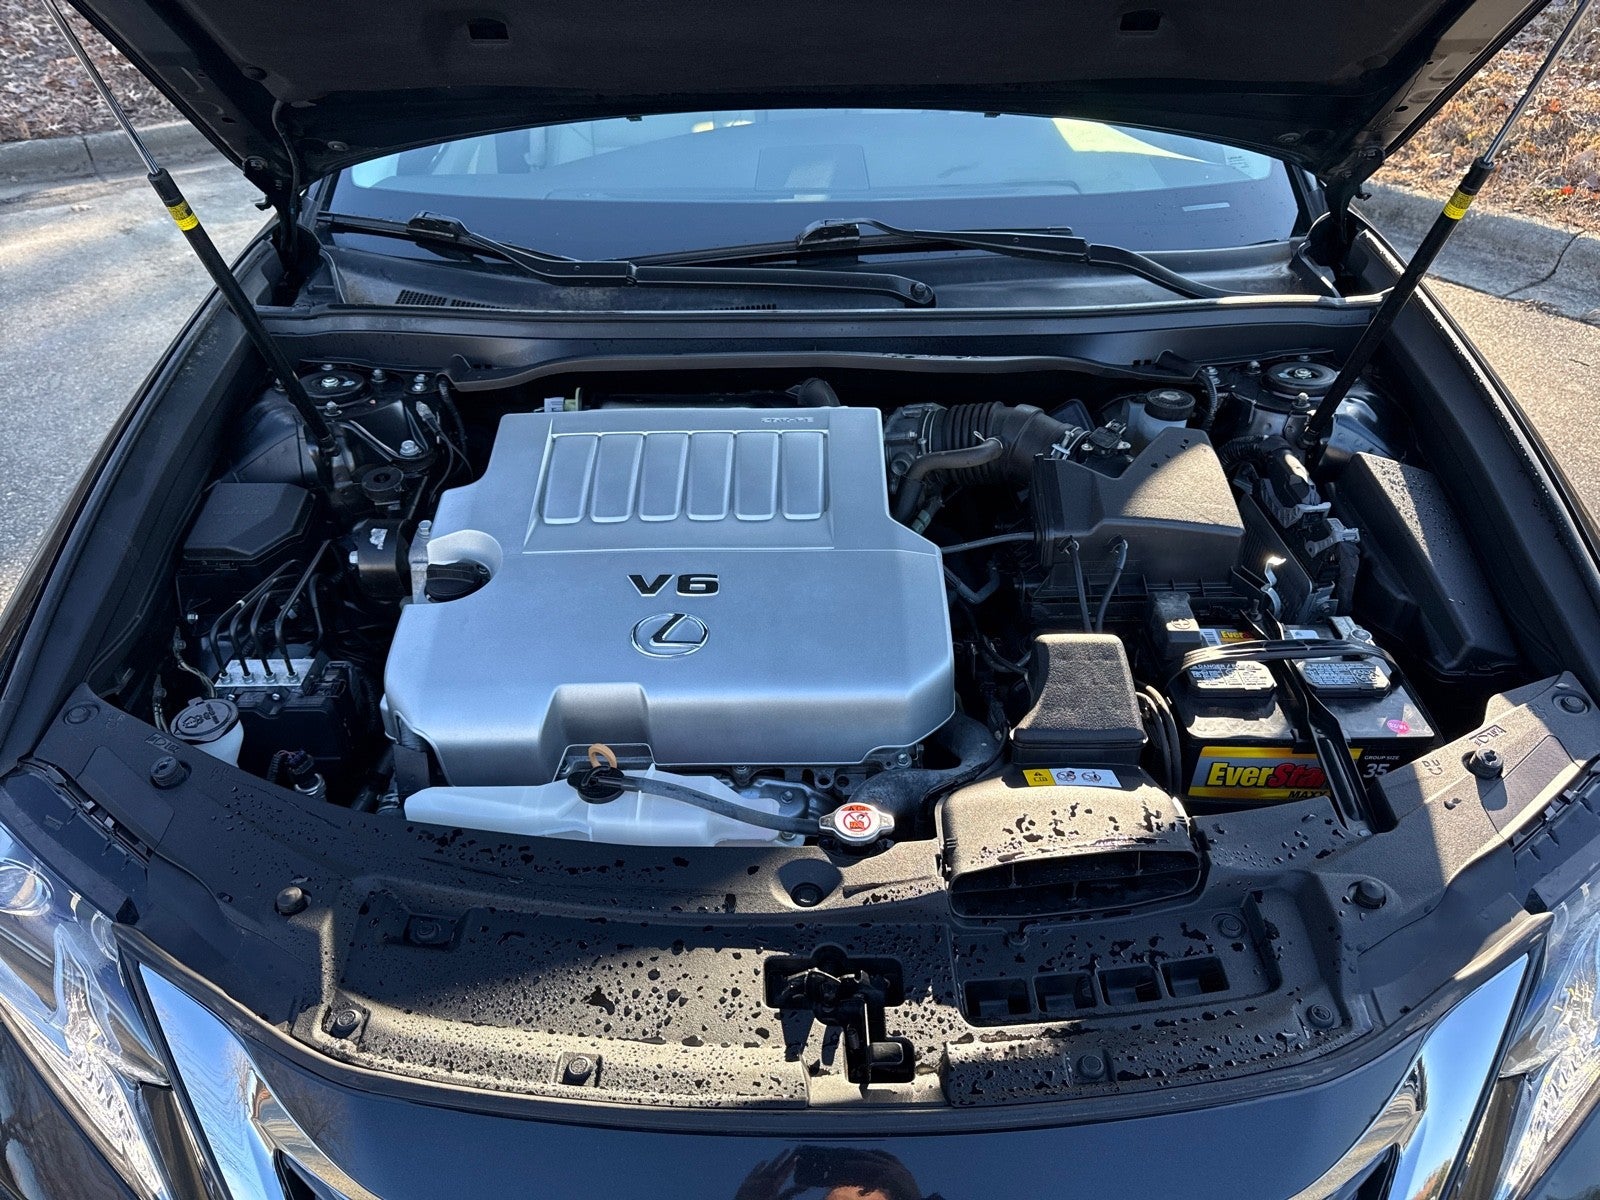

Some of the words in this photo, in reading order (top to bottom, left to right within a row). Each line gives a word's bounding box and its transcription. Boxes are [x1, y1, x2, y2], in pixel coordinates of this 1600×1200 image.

[627, 573, 719, 597] V6
[1206, 761, 1326, 788] EverSta
[1363, 763, 1391, 778] 35
